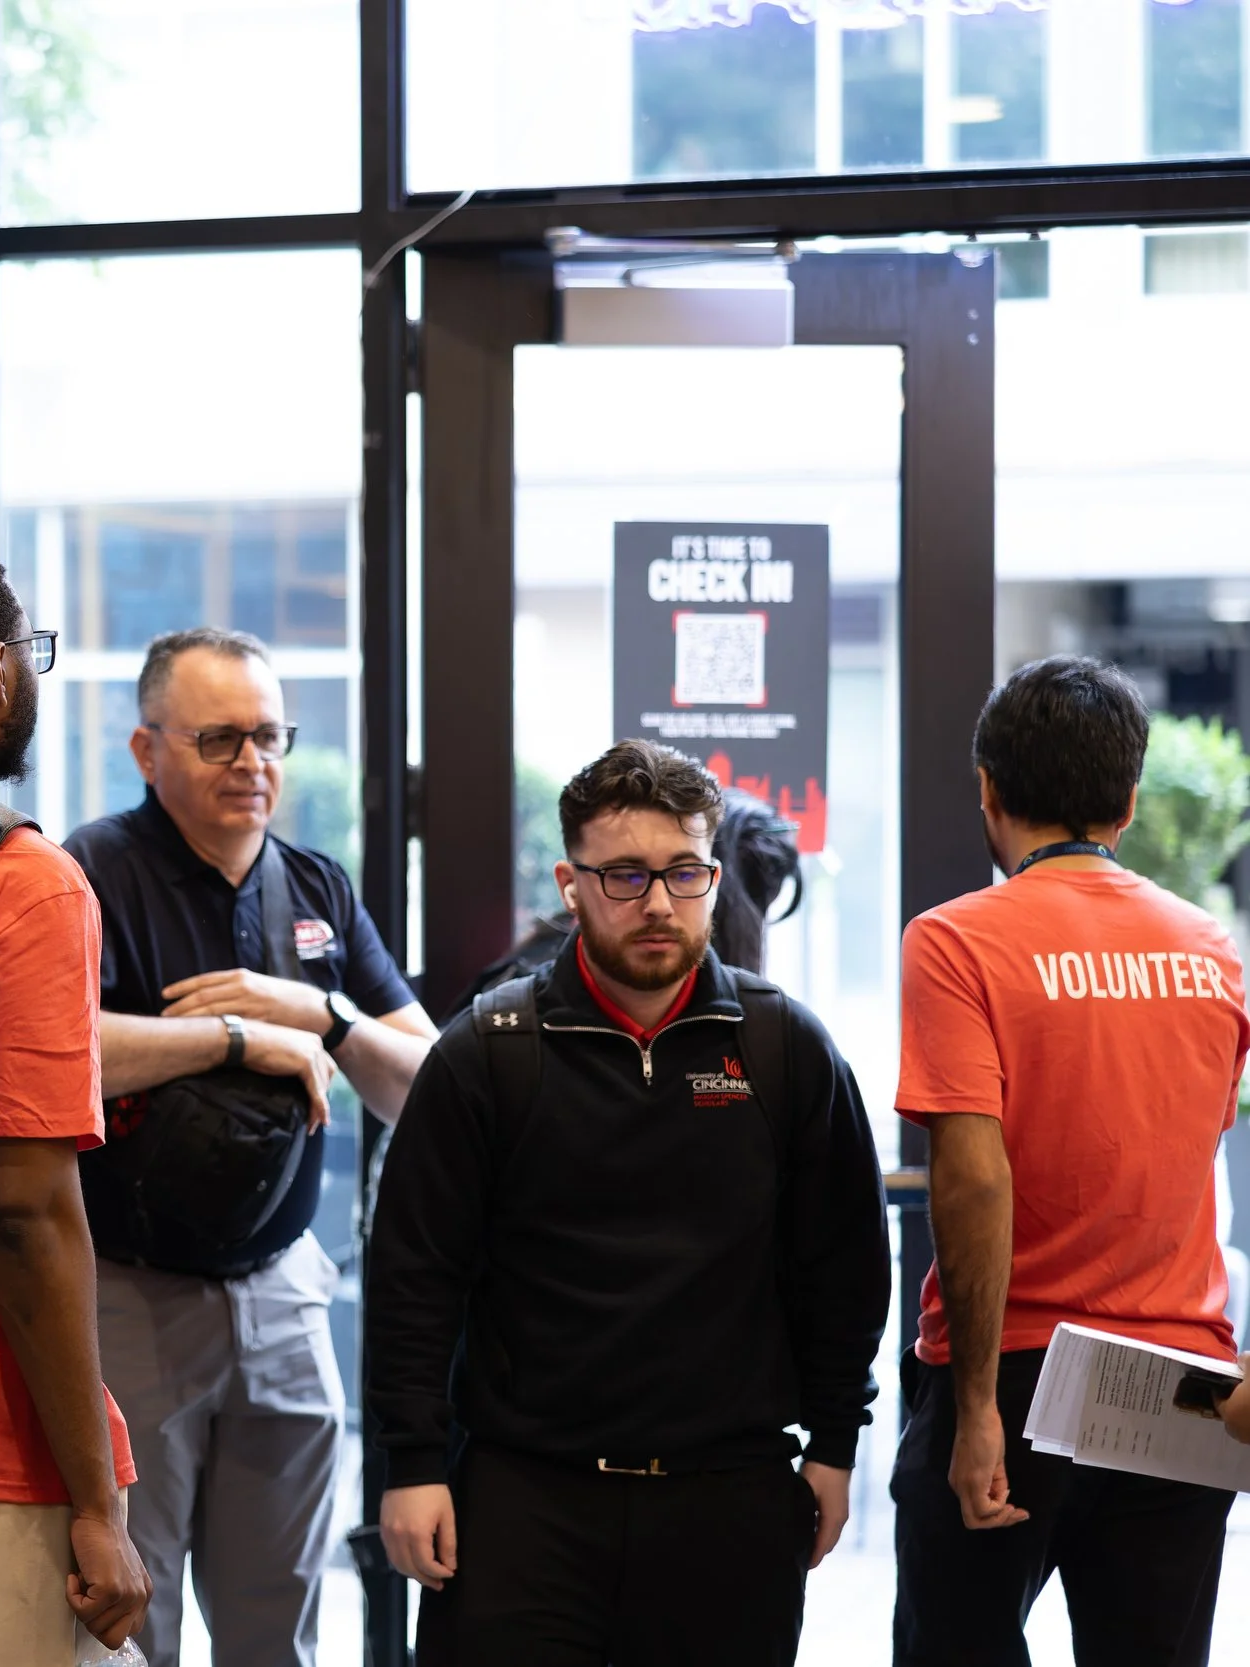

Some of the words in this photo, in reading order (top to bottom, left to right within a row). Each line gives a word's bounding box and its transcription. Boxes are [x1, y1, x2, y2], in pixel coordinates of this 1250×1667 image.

[707, 535, 747, 560] TIME
[748, 536, 772, 561] TO
[648, 558, 748, 602] CHECK
[1032, 951, 1232, 1001] VOLUNTEER
